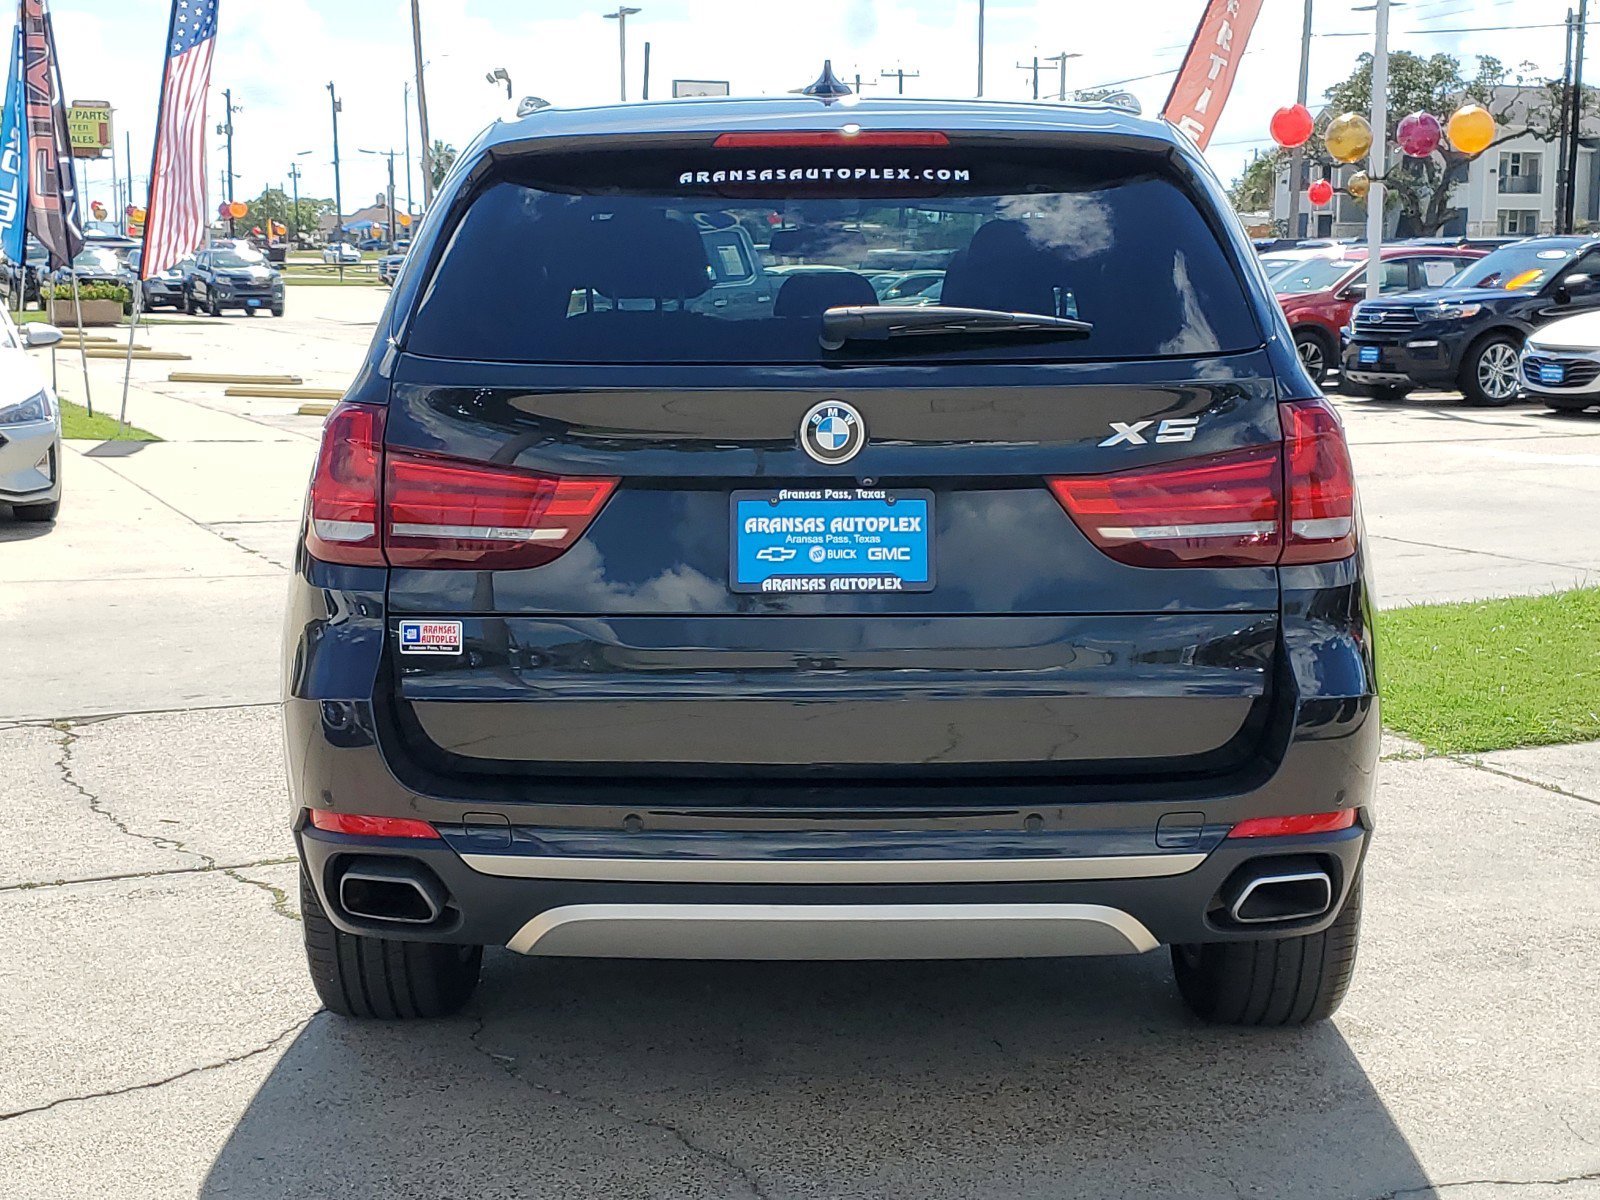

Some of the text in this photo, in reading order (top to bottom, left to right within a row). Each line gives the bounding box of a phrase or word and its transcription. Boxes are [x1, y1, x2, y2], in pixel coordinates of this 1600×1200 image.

[76, 111, 109, 121] PARTS
[71, 136, 94, 144] ALES
[679, 168, 970, 184] ARANSASAUTOPLEX.COM
[811, 407, 856, 426] BMW
[1097, 416, 1200, 448] X5
[779, 489, 886, 500] Aransas Pass, Texas
[744, 517, 922, 533] ARANSAS AUTOPLEX
[785, 534, 881, 545] Aransas Pass, Texas
[827, 549, 857, 560] BUICK
[867, 547, 911, 561] GMC
[762, 578, 903, 591] ARANSAS AUTOPLEX
[422, 625, 456, 634] ARANSAS
[421, 635, 457, 643] AUTOPLEX
